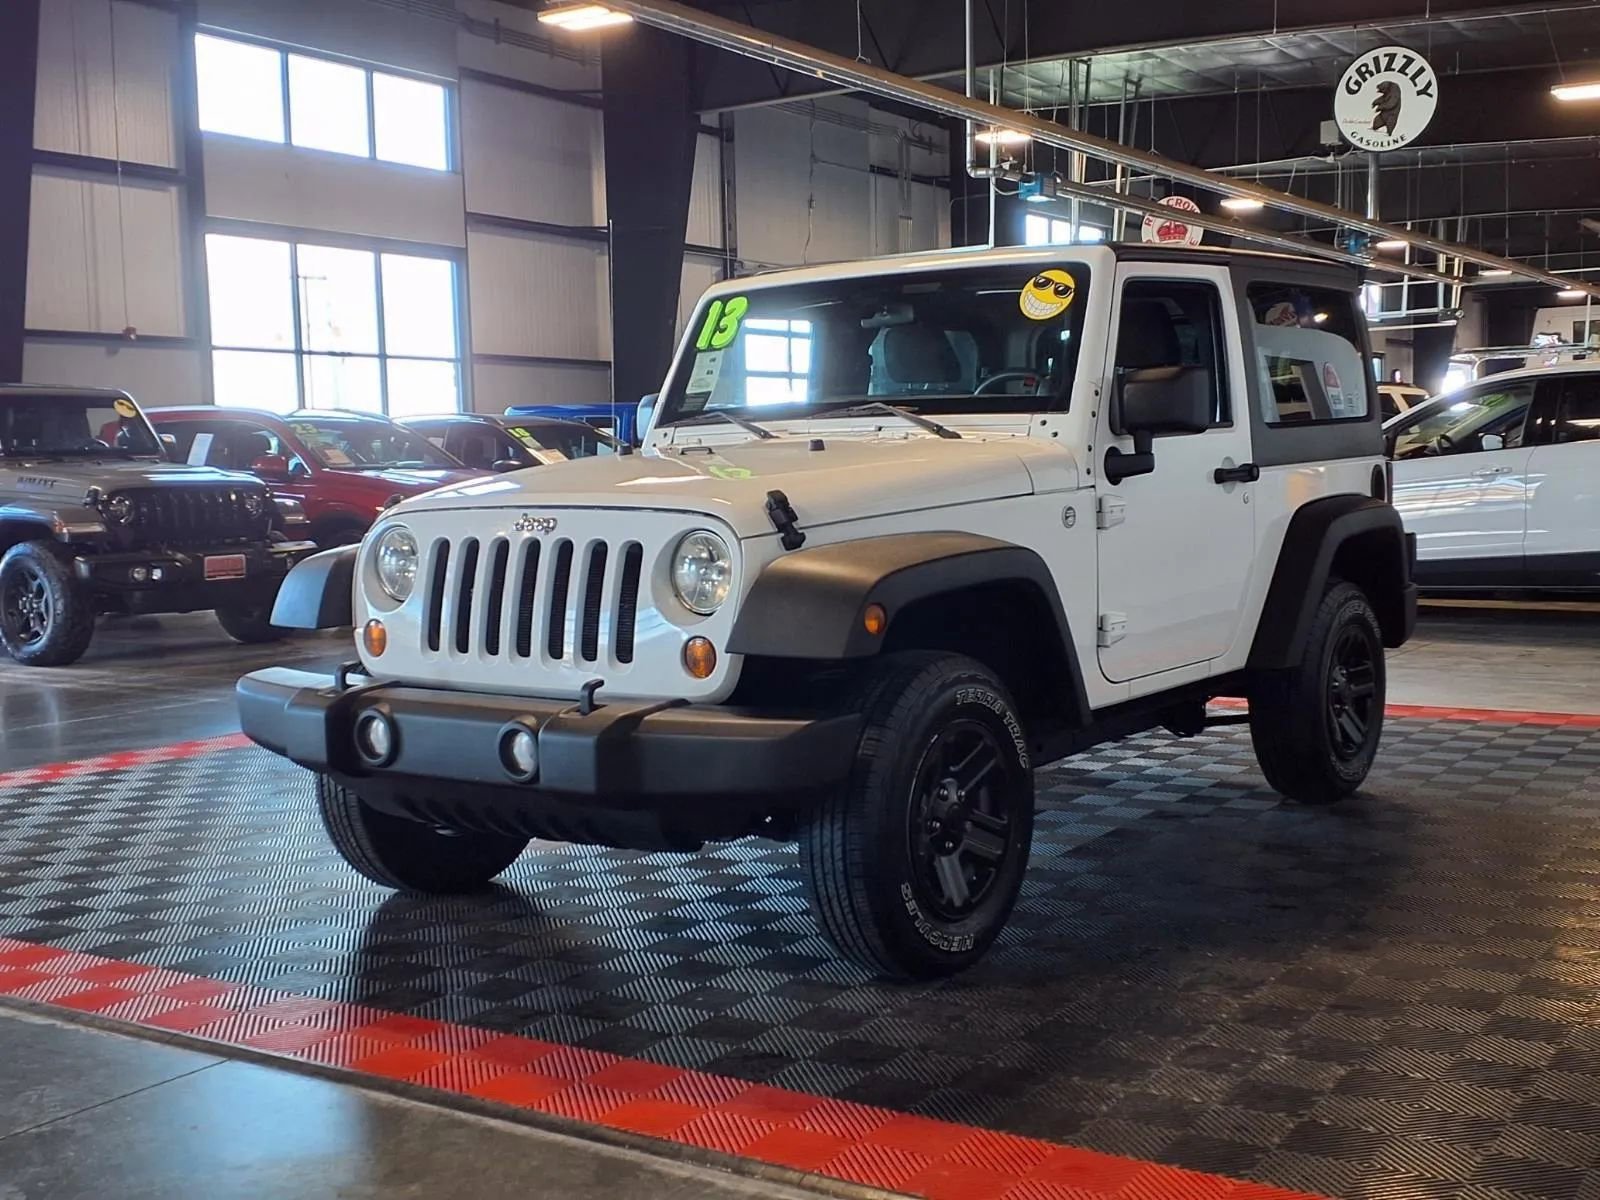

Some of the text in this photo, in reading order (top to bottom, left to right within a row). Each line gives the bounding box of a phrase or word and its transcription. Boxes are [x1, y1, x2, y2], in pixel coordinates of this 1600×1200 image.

[1345, 53, 1434, 98] GRIZZLY
[1350, 131, 1407, 148] GASOLINE
[696, 296, 748, 350] 13
[955, 688, 1004, 714] TERRA
[901, 881, 975, 952] HERCULES
